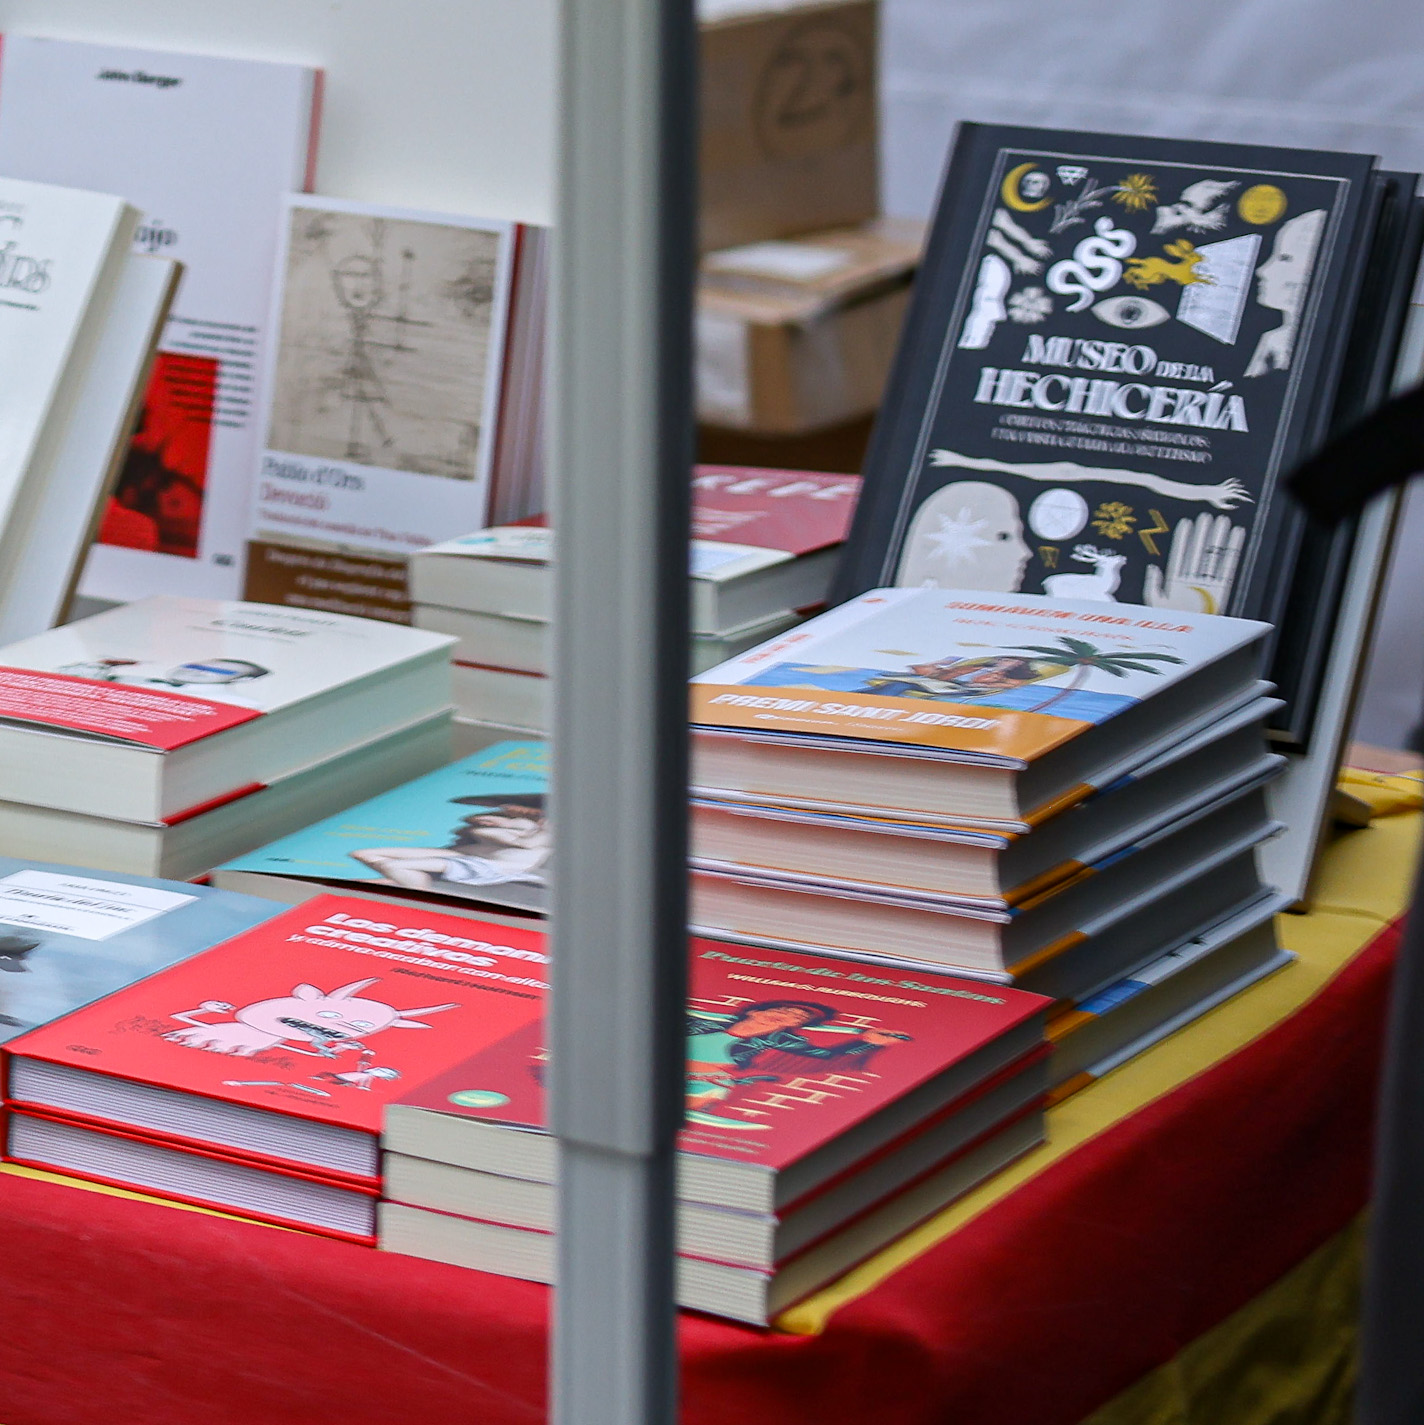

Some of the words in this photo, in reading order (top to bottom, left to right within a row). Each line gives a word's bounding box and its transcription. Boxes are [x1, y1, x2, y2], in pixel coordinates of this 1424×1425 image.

[1021, 333, 1158, 376] MUSEO
[973, 366, 1250, 434] HECHICERÍA
[707, 693, 816, 714] PREMI
[811, 702, 909, 722] SANT
[898, 711, 1002, 731] JORDI
[305, 925, 498, 967] creativos
[321, 912, 398, 934] Los
[394, 927, 552, 965] demon
[503, 974, 552, 992] ello
